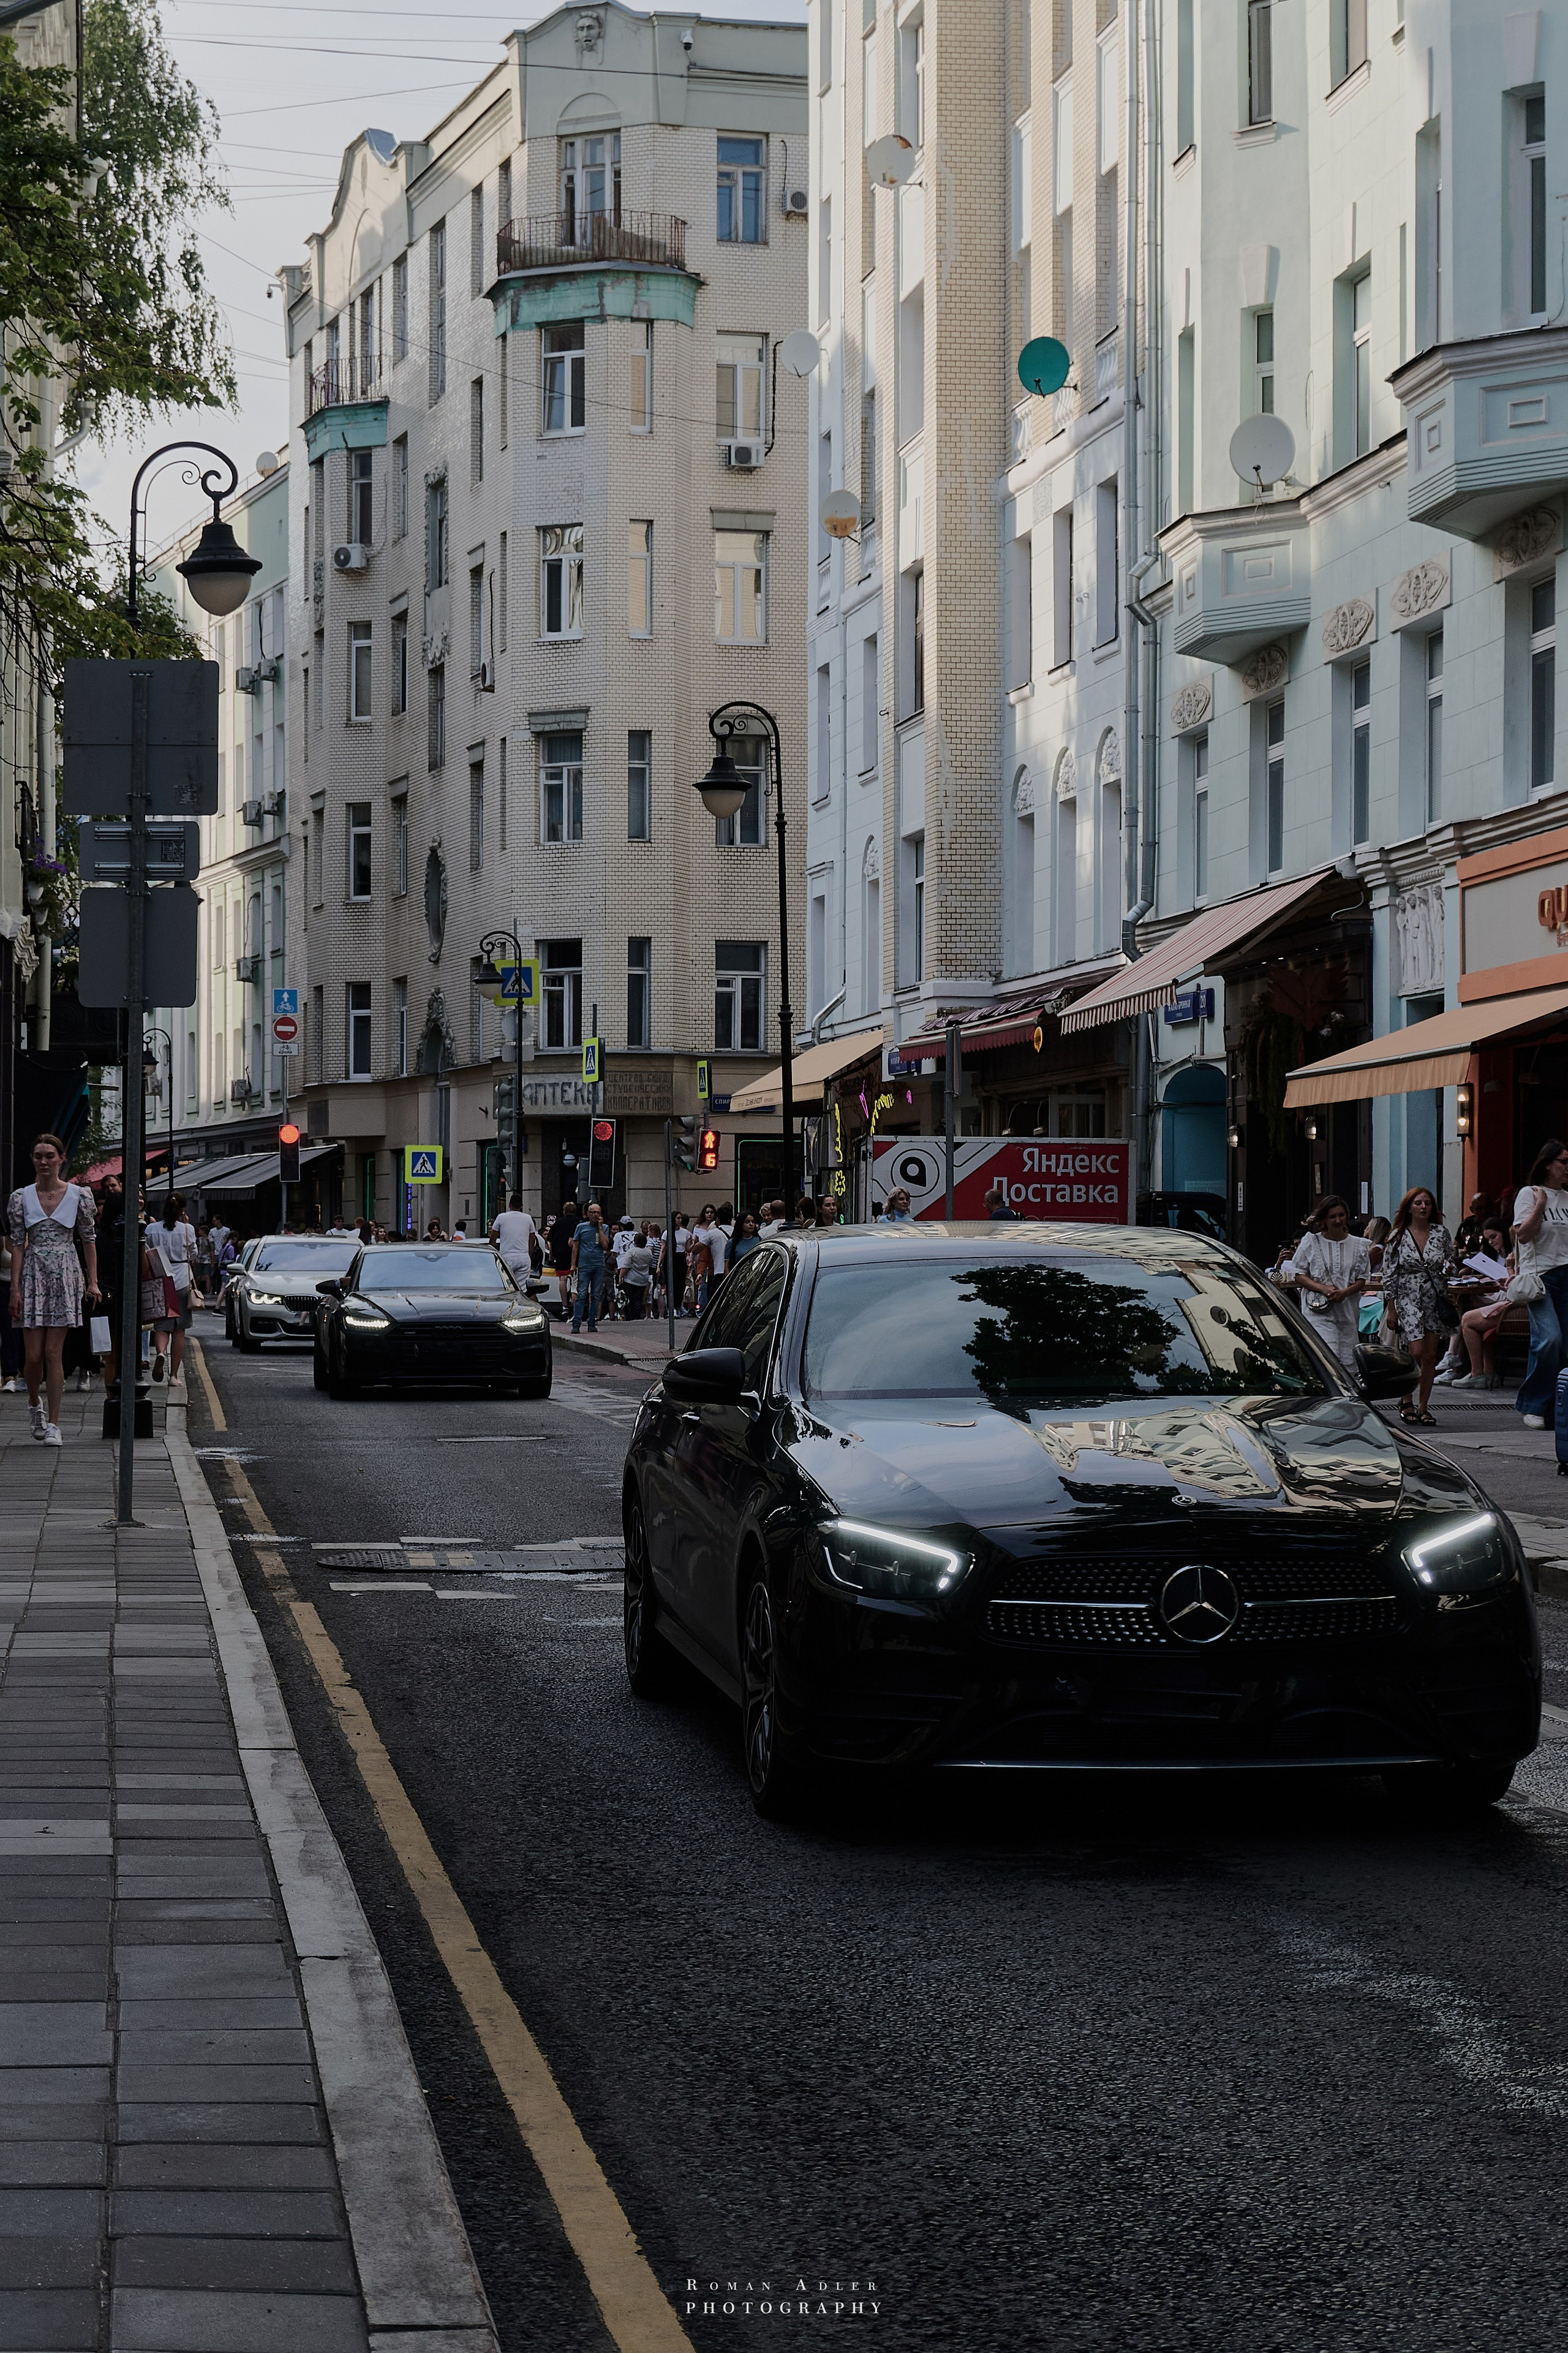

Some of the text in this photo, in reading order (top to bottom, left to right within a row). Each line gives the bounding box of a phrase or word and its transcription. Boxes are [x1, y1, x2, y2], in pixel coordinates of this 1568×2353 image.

[1200, 994, 1206, 1008] 20
[705, 1152, 716, 1167] 6
[1022, 1147, 1120, 1177] Яндекс
[993, 1177, 1118, 1207] Доставка
